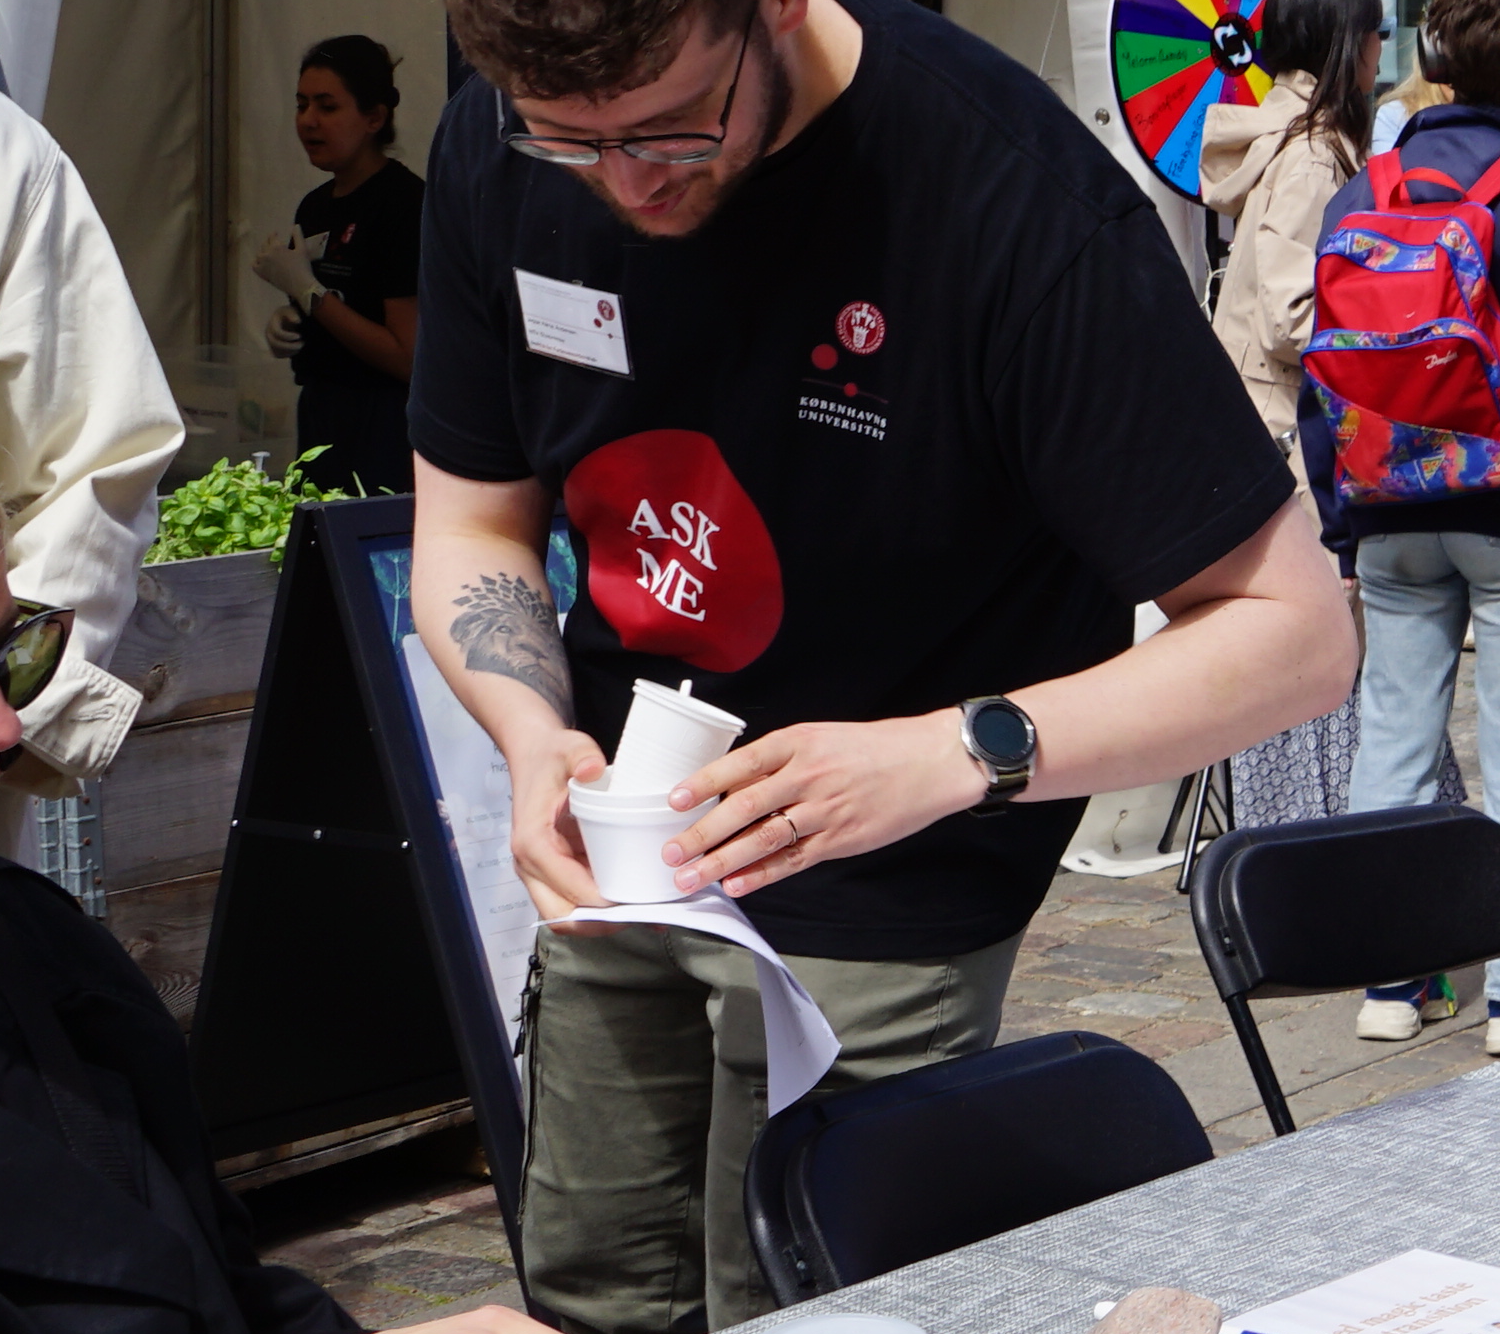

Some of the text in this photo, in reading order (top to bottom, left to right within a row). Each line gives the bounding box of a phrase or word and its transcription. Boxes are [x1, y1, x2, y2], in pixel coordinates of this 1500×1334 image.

[798, 410, 886, 441] UNIVERSITET
[799, 396, 887, 428] KØBENHAVNS
[626, 498, 720, 571] ASK
[637, 548, 706, 622] ME
[1361, 1301, 1427, 1329] magic
[1419, 1279, 1474, 1305] taste
